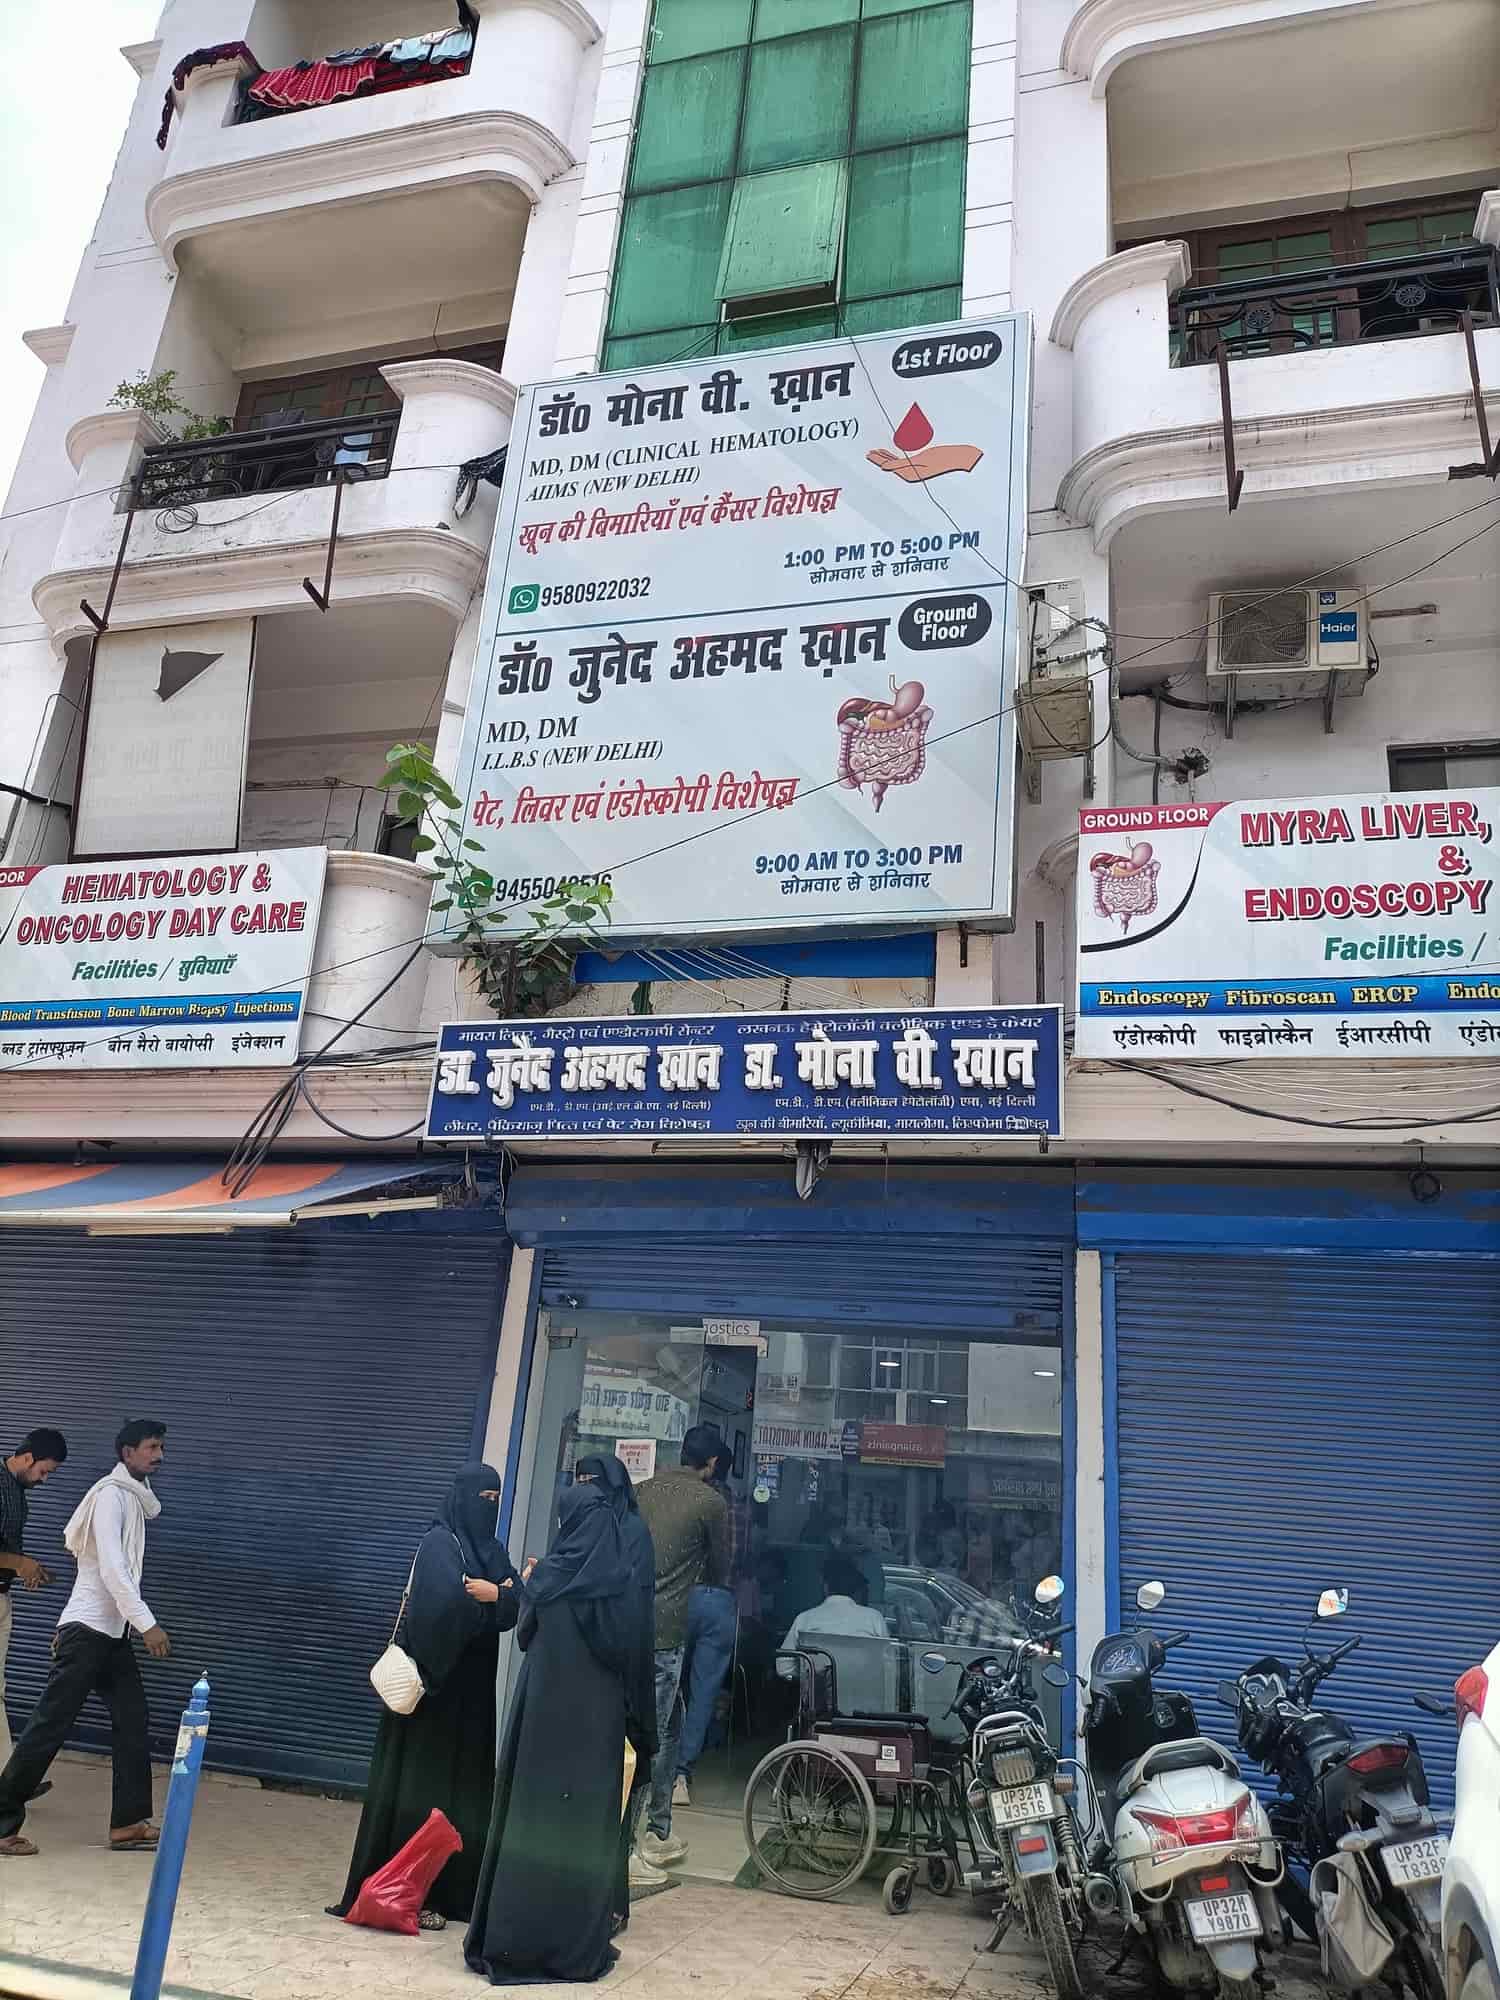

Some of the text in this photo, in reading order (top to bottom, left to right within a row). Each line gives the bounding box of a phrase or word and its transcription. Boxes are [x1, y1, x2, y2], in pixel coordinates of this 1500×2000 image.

[896, 340, 994, 371] 1st Floor
[607, 383, 689, 428] मोना
[700, 369, 749, 416] वी.
[528, 419, 859, 479] MD, DM (CLINICAL HEMATOLOGY)
[526, 466, 701, 502] AIIMS (NEW DELHI)
[519, 521, 556, 555] खून
[558, 511, 584, 542] की
[679, 496, 708, 529] एवं
[711, 493, 761, 524] कैंसर
[764, 483, 843, 520] विशेषज्ञ
[784, 530, 981, 568] 1:00 PM TO 5:00 PM
[809, 555, 949, 586] सोमवार से शनिवार
[541, 577, 651, 608] 9580922032
[913, 603, 978, 626] Ground
[1321, 623, 1355, 632] Haier
[921, 622, 968, 641] Floor
[569, 633, 659, 703] जुनेद
[670, 628, 788, 680] अहमद
[486, 716, 578, 745] MD, DM
[541, 745, 594, 768] (NEW
[596, 739, 663, 763] DELHI)
[472, 770, 801, 829] पेट, लिवर एवं एंडोस्कोपी विशेषज्ञ
[1084, 807, 1209, 828] GROUND FLOOR
[1240, 801, 1491, 846] MYRA LIVER,
[755, 845, 963, 875] 9:00 AM TO 3:00 PM
[1437, 845, 1471, 875] &
[61, 863, 272, 904] HEMATOLOGY &
[780, 869, 931, 896] सोमवार से शनिवार
[1245, 880, 1492, 920] ENDOSCOPY
[16, 901, 307, 945] ONCOLOGY DAY CARE
[1324, 935, 1464, 961] Facilities
[72, 958, 158, 981] Facilities
[1, 1009, 32, 1022] Blood
[35, 1007, 101, 1020] Transfusion
[107, 1006, 135, 1018] Bone
[138, 1004, 186, 1017] Marrow
[233, 1001, 294, 1014] Injections
[1098, 991, 1211, 1008] Endoscopy
[1225, 989, 1336, 1006] Fibroscan
[1351, 987, 1419, 1004] ERCP
[231, 1034, 286, 1053] इंजेक्शन
[1112, 1021, 1196, 1049] एंडोस्कोपी
[1218, 1019, 1314, 1048] फाइब्रोस्कैन
[1336, 1020, 1431, 1048] ईआरसीपी
[561, 1045, 650, 1093] अहमद
[657, 1045, 723, 1092] खान
[795, 1029, 879, 1090] मोना
[893, 1029, 942, 1090] वी.
[1006, 1095, 1036, 1107] दिल्ली
[1000, 1789, 1042, 1805] UP32H
[1202, 1896, 1247, 1916] UP32H
